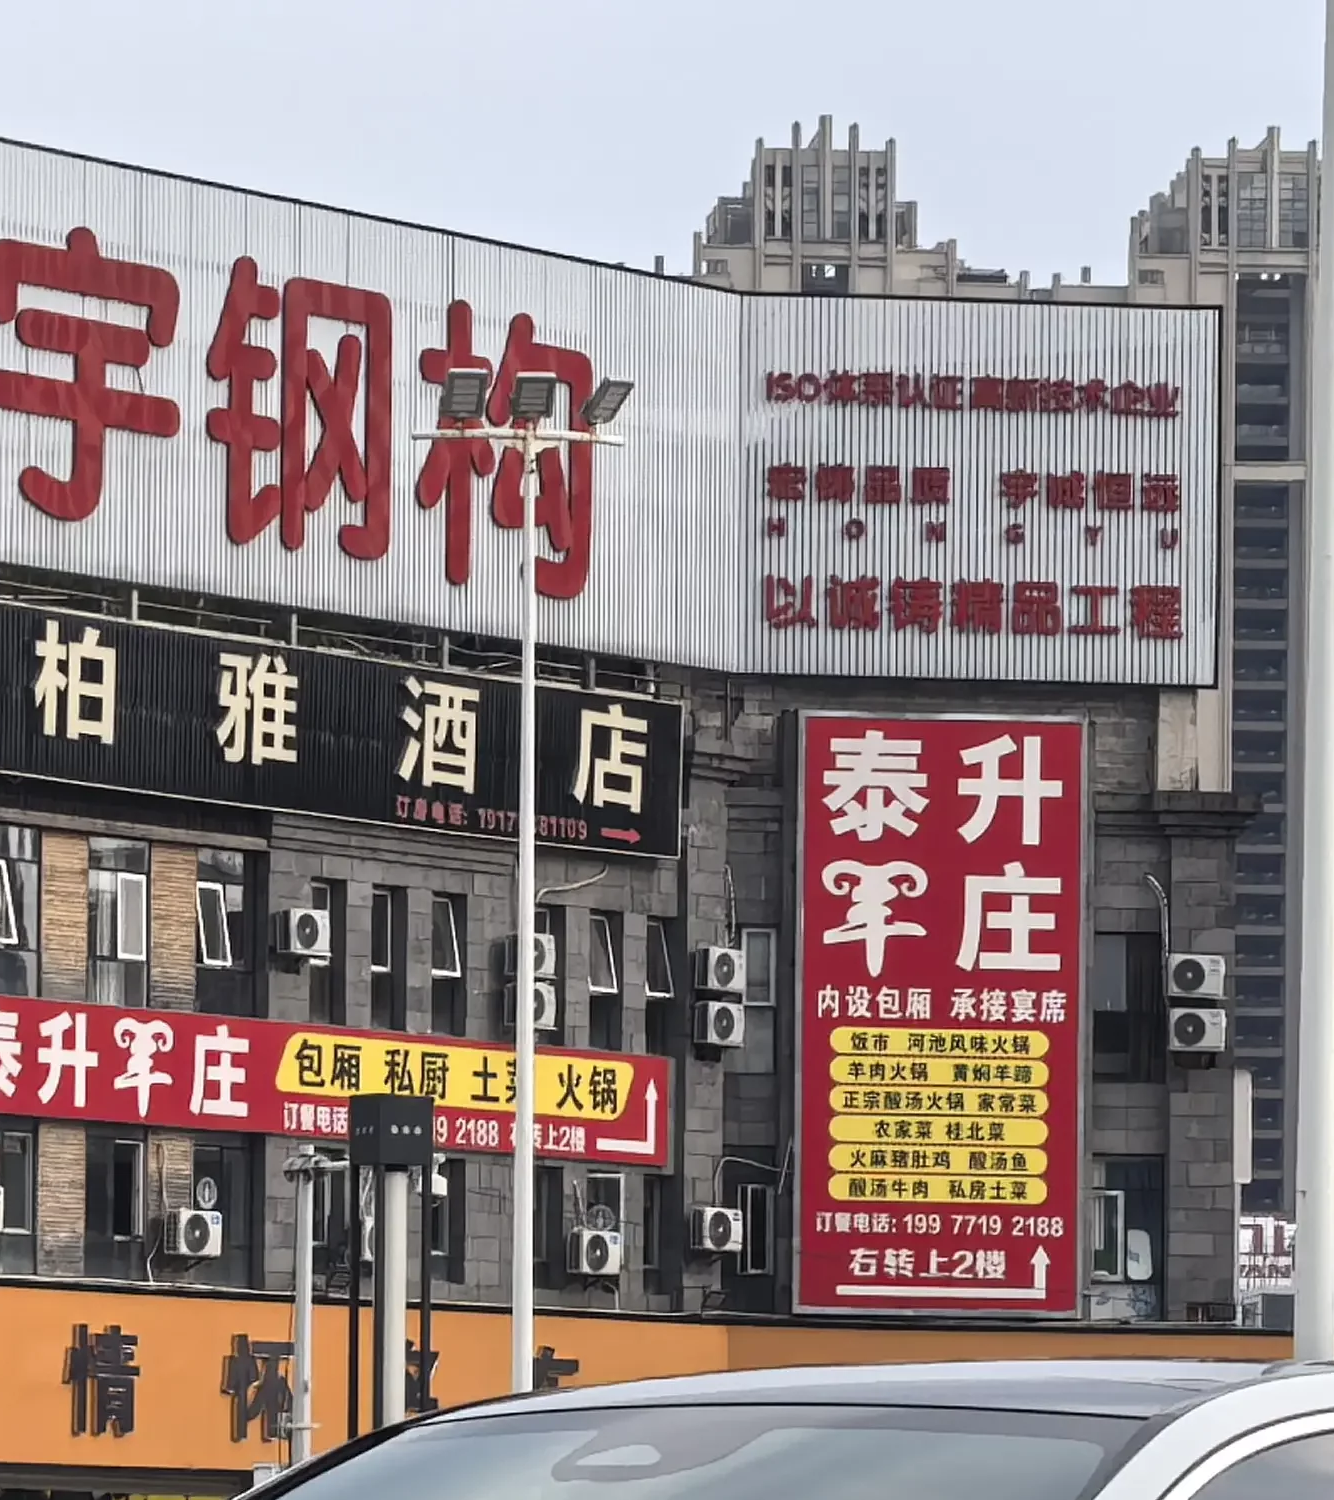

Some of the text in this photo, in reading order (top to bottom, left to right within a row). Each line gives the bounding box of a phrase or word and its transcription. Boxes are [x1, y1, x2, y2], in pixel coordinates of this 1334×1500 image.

[33, 619, 648, 814] 柏雅酒店
[822, 730, 1063, 846] 泰升
[821, 859, 1062, 978] 羊庄
[817, 985, 1067, 1023] 内设包厢 承接宴席
[908, 1033, 1031, 1055] 河池风味火锅
[295, 1039, 362, 1091] 包厢
[384, 1049, 449, 1099] 私厨
[556, 1064, 618, 1114] 火锅
[847, 1062, 929, 1082] 羊肉火锅
[842, 1090, 1037, 1113] 正宗酸汤火锅 家常菜
[455, 1118, 499, 1147] 2188
[874, 1120, 932, 1140] 农家菜
[850, 1149, 1029, 1171] 火麻猪肚鸡 酸汤鱼
[849, 1178, 1028, 1200] 酸汤牛肉 私房土菜
[903, 1214, 941, 1235] 199
[951, 1215, 1002, 1236] 7719
[1011, 1216, 1064, 1237] 2188
[849, 1248, 1006, 1280] 右转上2楼
